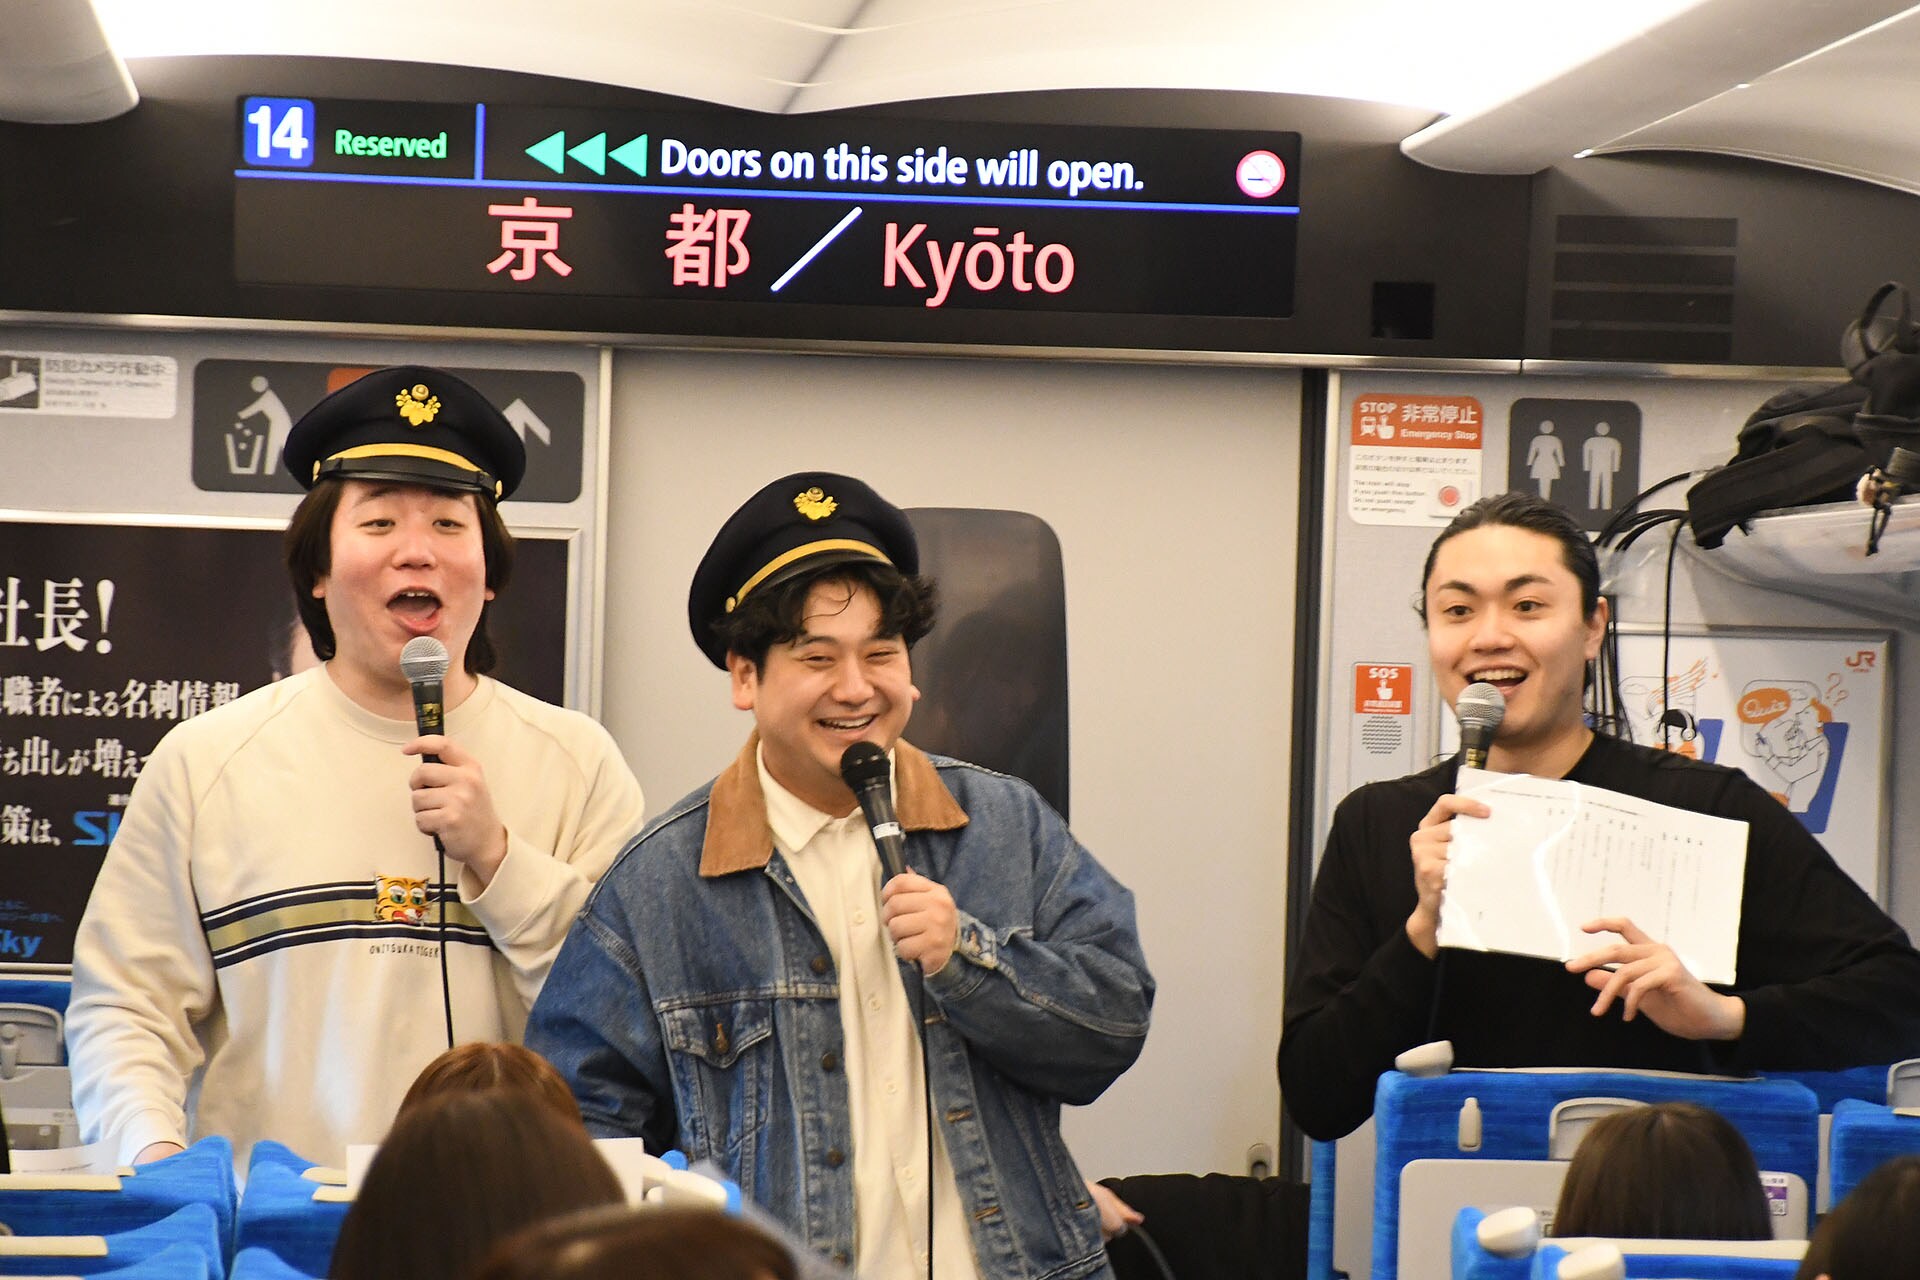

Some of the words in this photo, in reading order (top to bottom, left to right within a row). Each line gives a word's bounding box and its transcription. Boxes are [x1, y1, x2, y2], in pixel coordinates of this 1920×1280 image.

[247, 105, 309, 159] 14
[334, 129, 448, 159] Reserved
[660, 138, 763, 178] Doors
[769, 149, 815, 181] on
[824, 143, 888, 183] this
[899, 146, 968, 186] side
[975, 148, 1039, 189] will
[1047, 158, 1145, 198] open.
[882, 222, 1075, 307] Kyōto
[1360, 402, 1398, 413] STOP
[1401, 403, 1478, 425] 非常停止
[1400, 429, 1453, 440] Emergency
[1454, 430, 1478, 441] Stop
[1368, 667, 1399, 679] SOS
[1845, 650, 1876, 667] JR
[0, 675, 240, 720] 職者による名刺情報
[0, 736, 150, 778] ち出しが増え
[0, 928, 44, 958] ky
